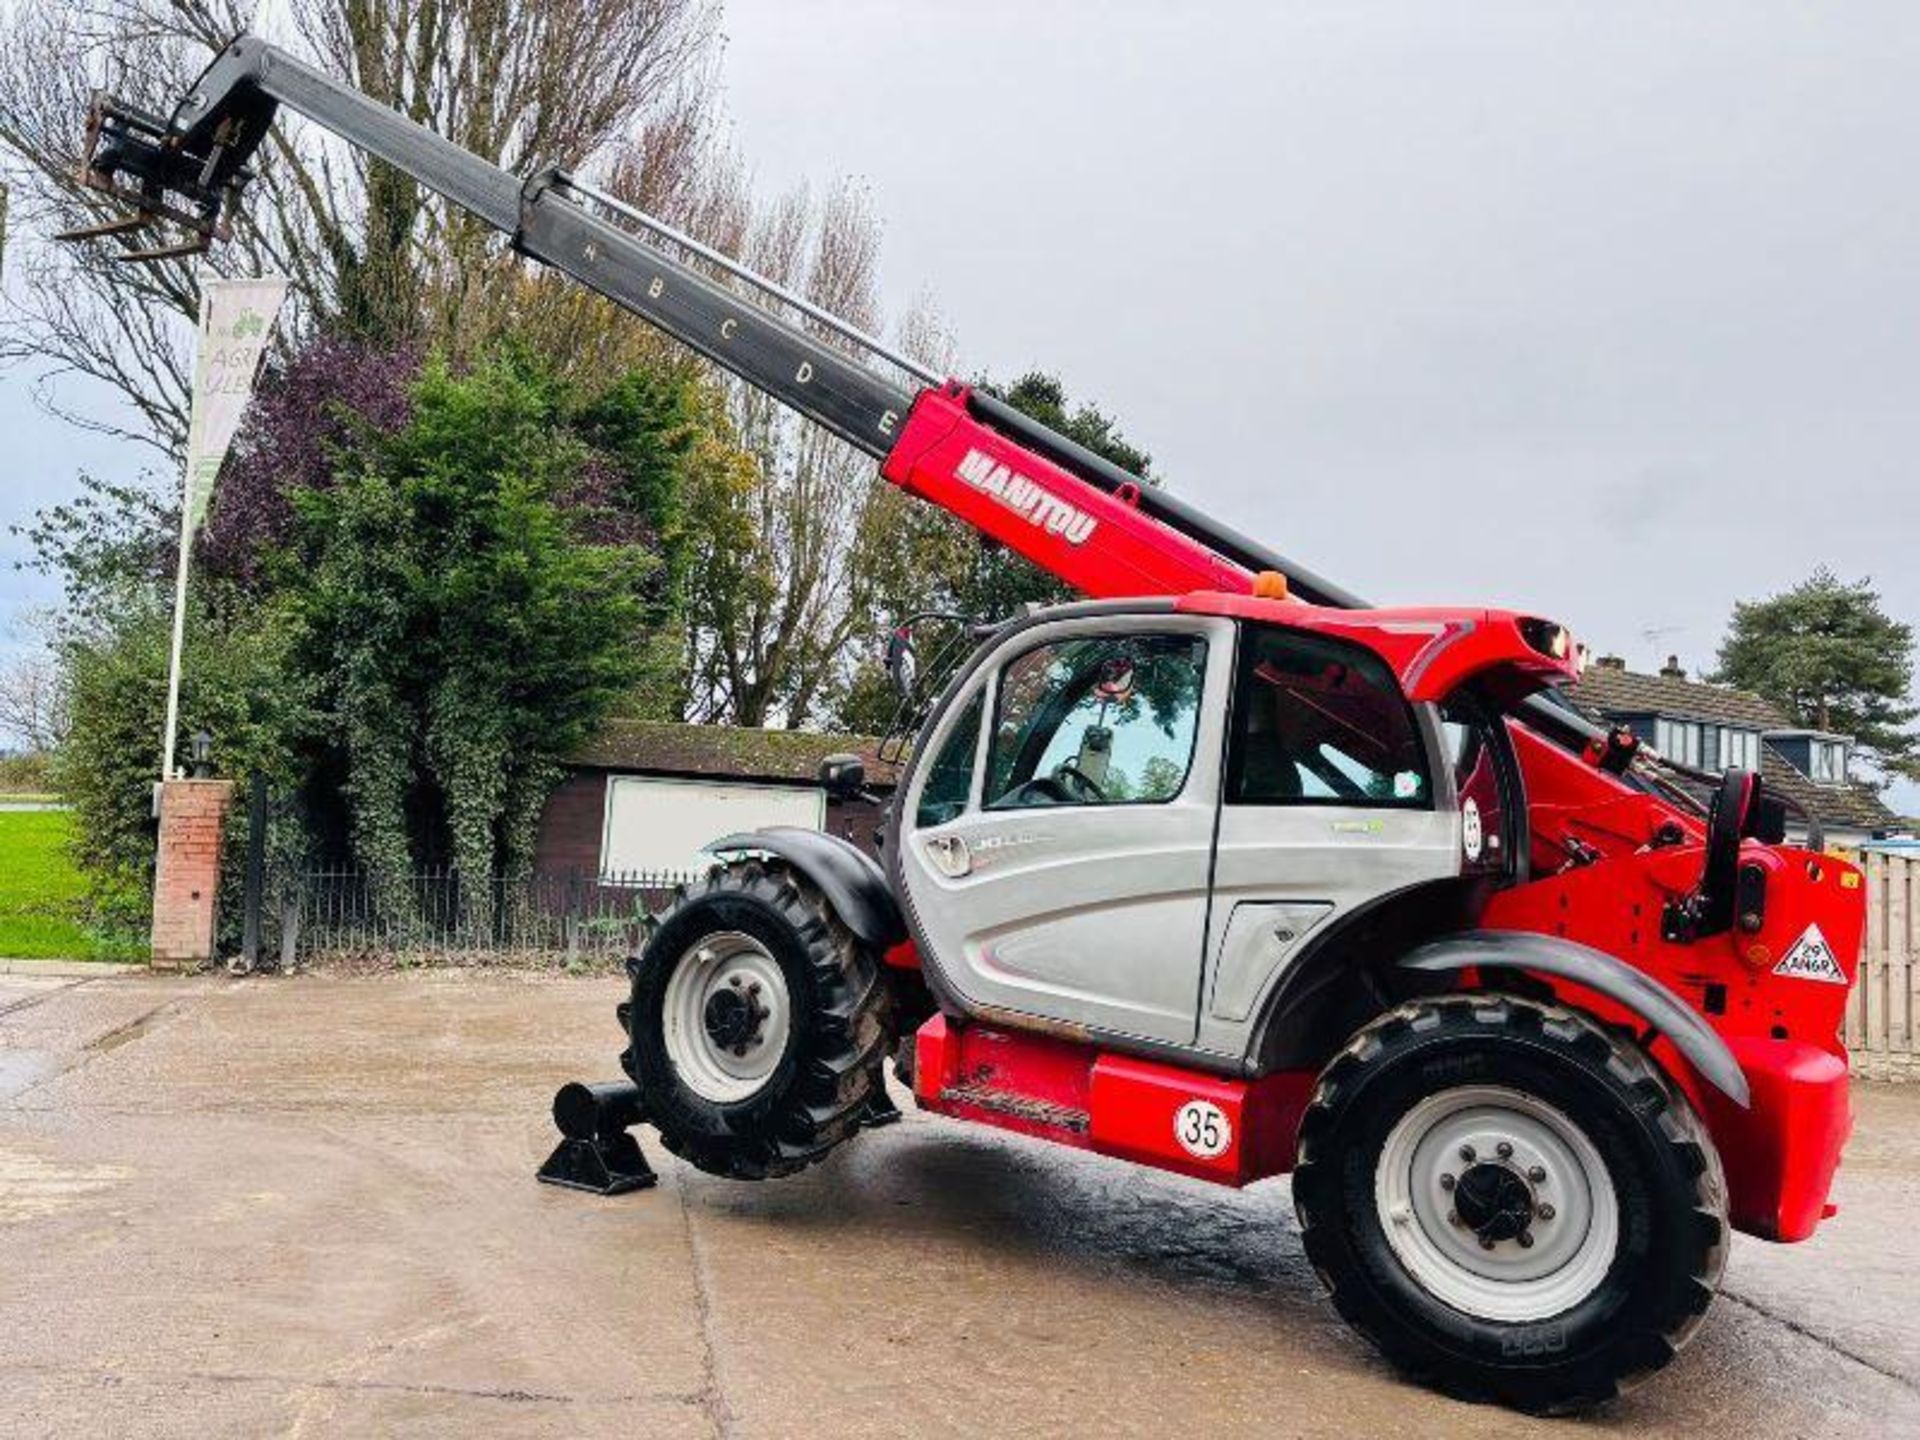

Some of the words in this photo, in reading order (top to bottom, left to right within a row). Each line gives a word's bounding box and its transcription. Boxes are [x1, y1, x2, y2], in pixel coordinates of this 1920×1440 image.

[648, 277, 663, 298] B
[721, 318, 737, 340] C
[795, 361, 812, 383] D
[878, 410, 899, 435] E
[954, 448, 1099, 544] MANITOU
[1185, 1108, 1219, 1148] 35
